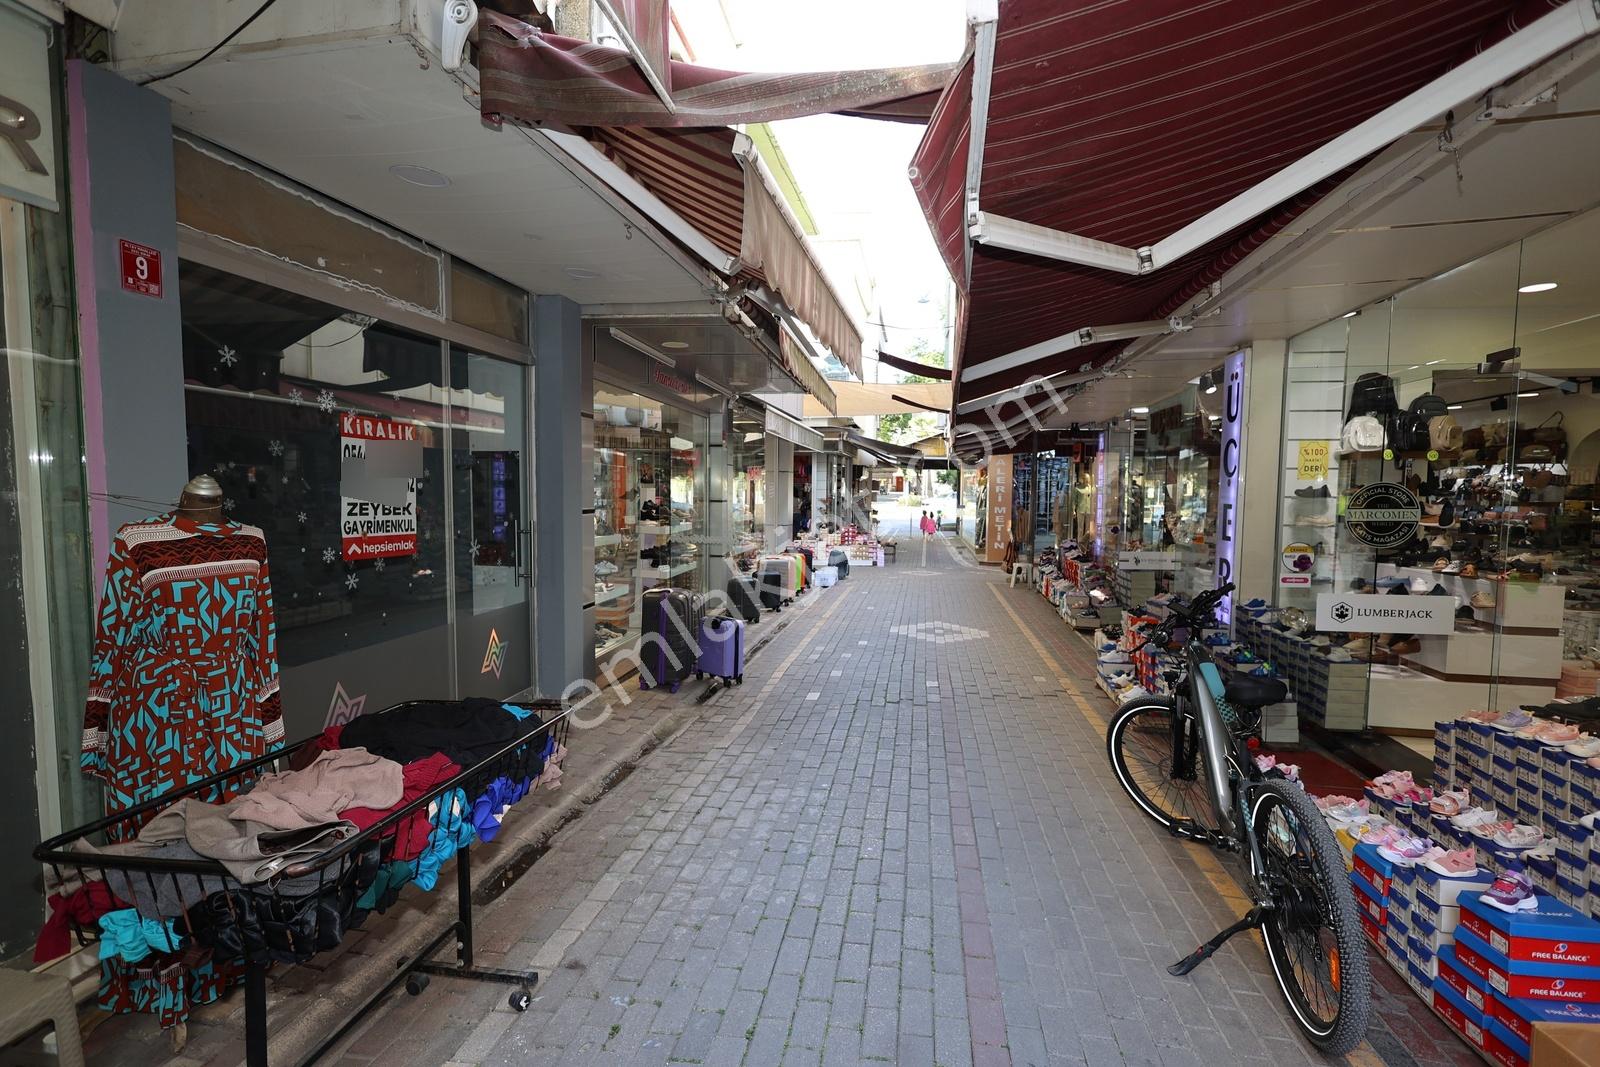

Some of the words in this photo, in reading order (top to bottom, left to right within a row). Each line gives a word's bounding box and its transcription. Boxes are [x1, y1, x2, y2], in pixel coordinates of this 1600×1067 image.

[136, 256, 148, 280] 9
[1304, 448, 1324, 456] %100
[1217, 371, 1239, 597] ÜÇER
[1356, 487, 1387, 505] OFFICIAL
[1388, 487, 1410, 504] STORE
[347, 502, 412, 517] ZEYBEK
[1348, 510, 1419, 520] MARCOMEN
[343, 517, 415, 535] GAYRİMENKUL
[362, 540, 414, 554] hepsiemlak
[1357, 608, 1433, 619] LUMBERJACK
[1531, 951, 1551, 959] FREE
[1552, 954, 1587, 962] BALANCE
[1529, 988, 1549, 996] FREE
[1549, 990, 1583, 998] BALANCE
